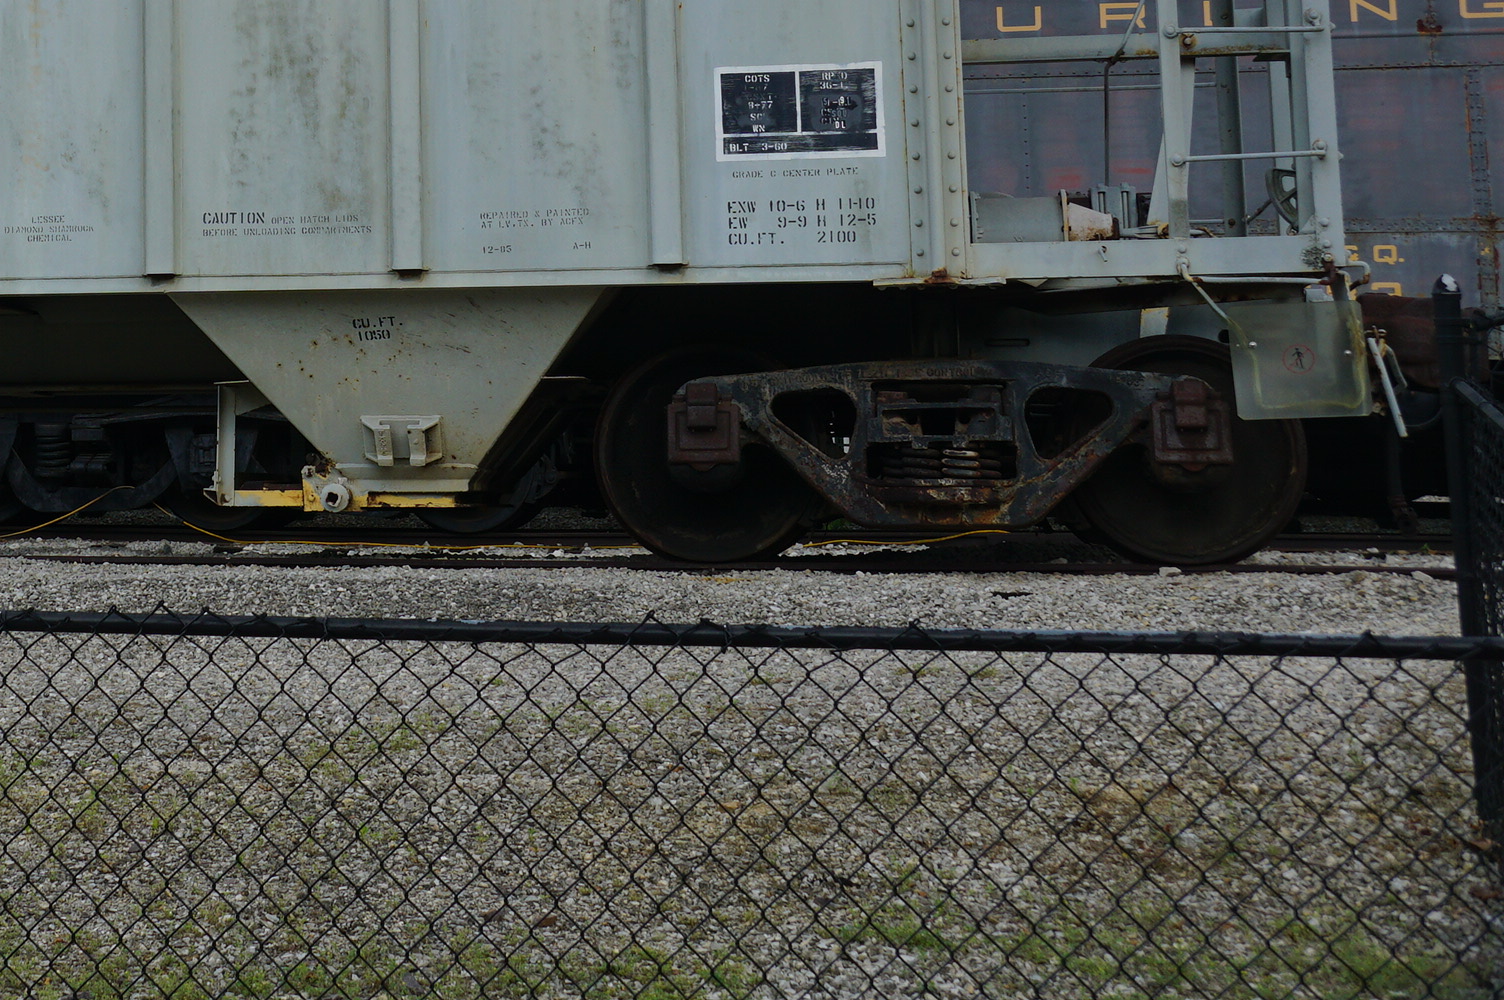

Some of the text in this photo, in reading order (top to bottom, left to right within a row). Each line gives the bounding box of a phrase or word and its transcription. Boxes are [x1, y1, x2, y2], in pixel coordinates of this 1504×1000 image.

[744, 74, 770, 83] COTS
[729, 142, 787, 152] BLT 3-60
[732, 167, 859, 178] GRADE C CENTER PLATE
[727, 197, 875, 213] EXW 10-6 H 11-10
[31, 215, 65, 224] LESSEE
[202, 212, 359, 225] CAUTION OPEN HATCH LIDS
[479, 211, 529, 220] REPAIRED
[546, 208, 590, 217] PAINTED
[481, 220, 493, 229] AT
[541, 218, 553, 227] BY
[560, 217, 584, 226] ACFX
[728, 213, 877, 229] EW 9-9 H 12-5
[4, 225, 94, 234] DIAMOND SHAMROCK
[202, 225, 372, 237] BEFORE UNLOADING COMPARTMENTS
[27, 234, 72, 243] CHEMICAL
[817, 231, 856, 243] 2100
[358, 329, 391, 341] 1050
